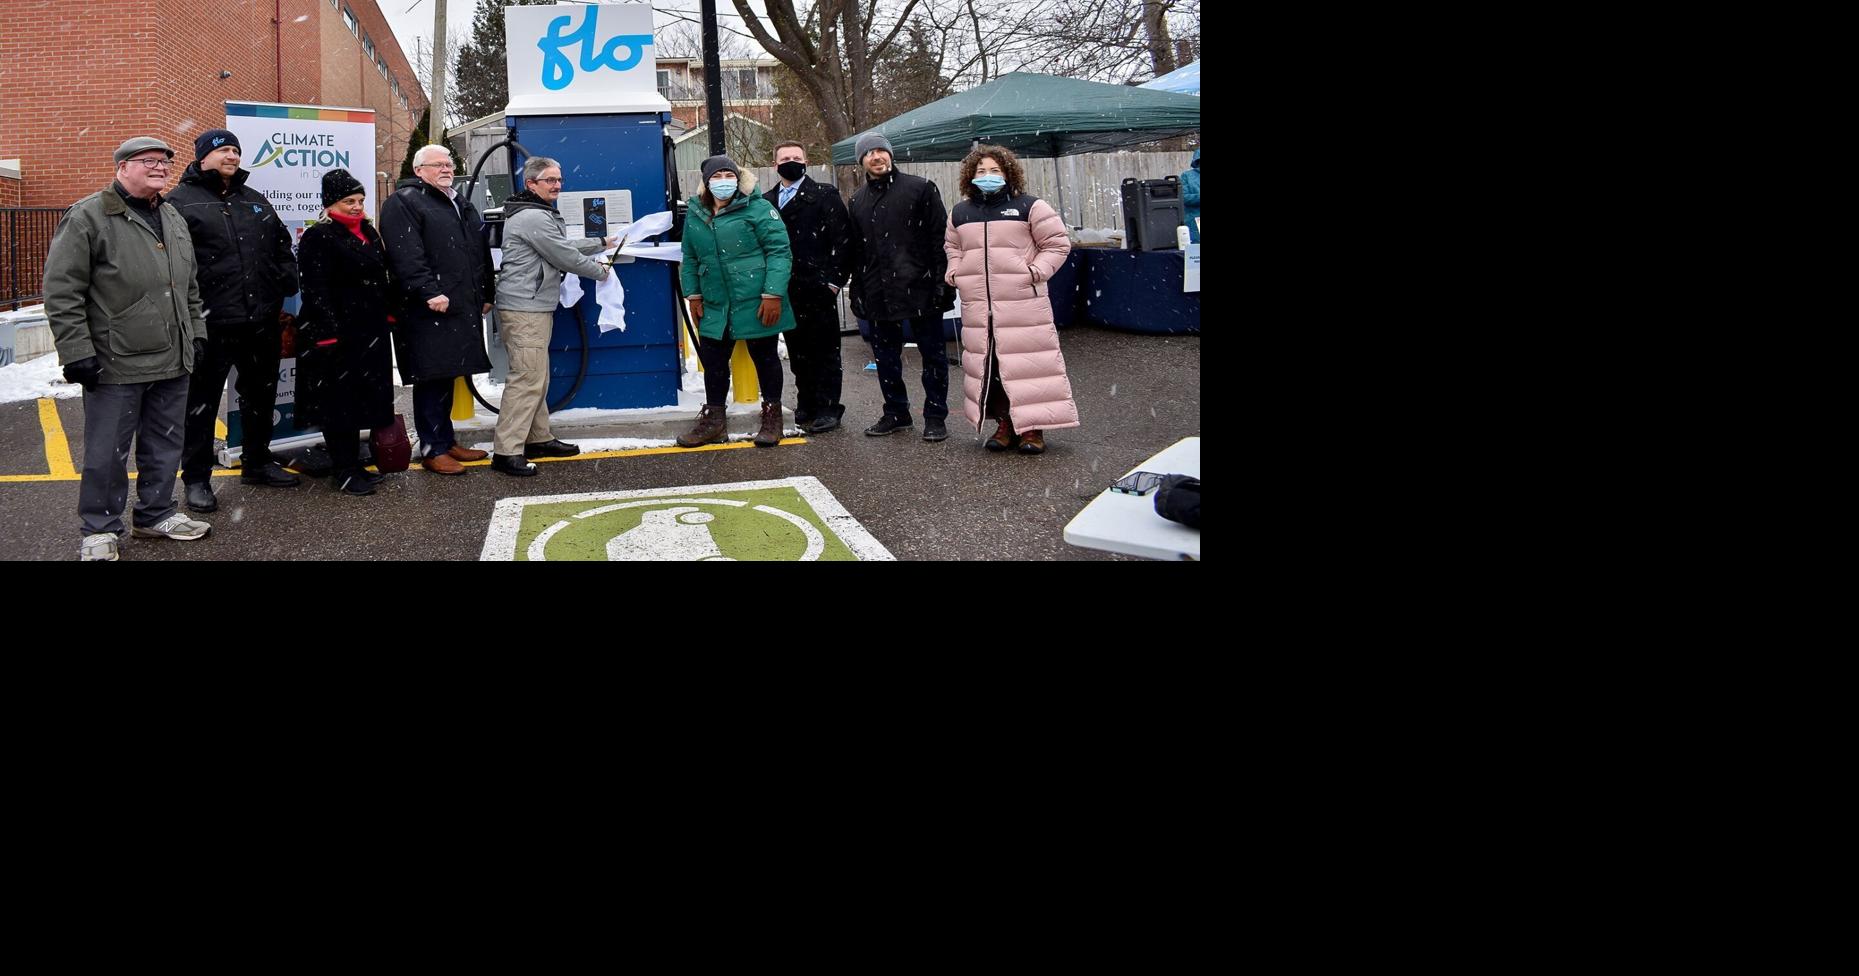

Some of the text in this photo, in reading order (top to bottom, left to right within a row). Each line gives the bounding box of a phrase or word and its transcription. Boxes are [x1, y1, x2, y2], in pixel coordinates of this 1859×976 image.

[537, 5, 653, 90] flo
[271, 132, 335, 146] CLIMATE
[250, 139, 350, 168] ACTION
[300, 170, 309, 178] in
[262, 190, 293, 201] ilding
[272, 203, 295, 211] ure,
